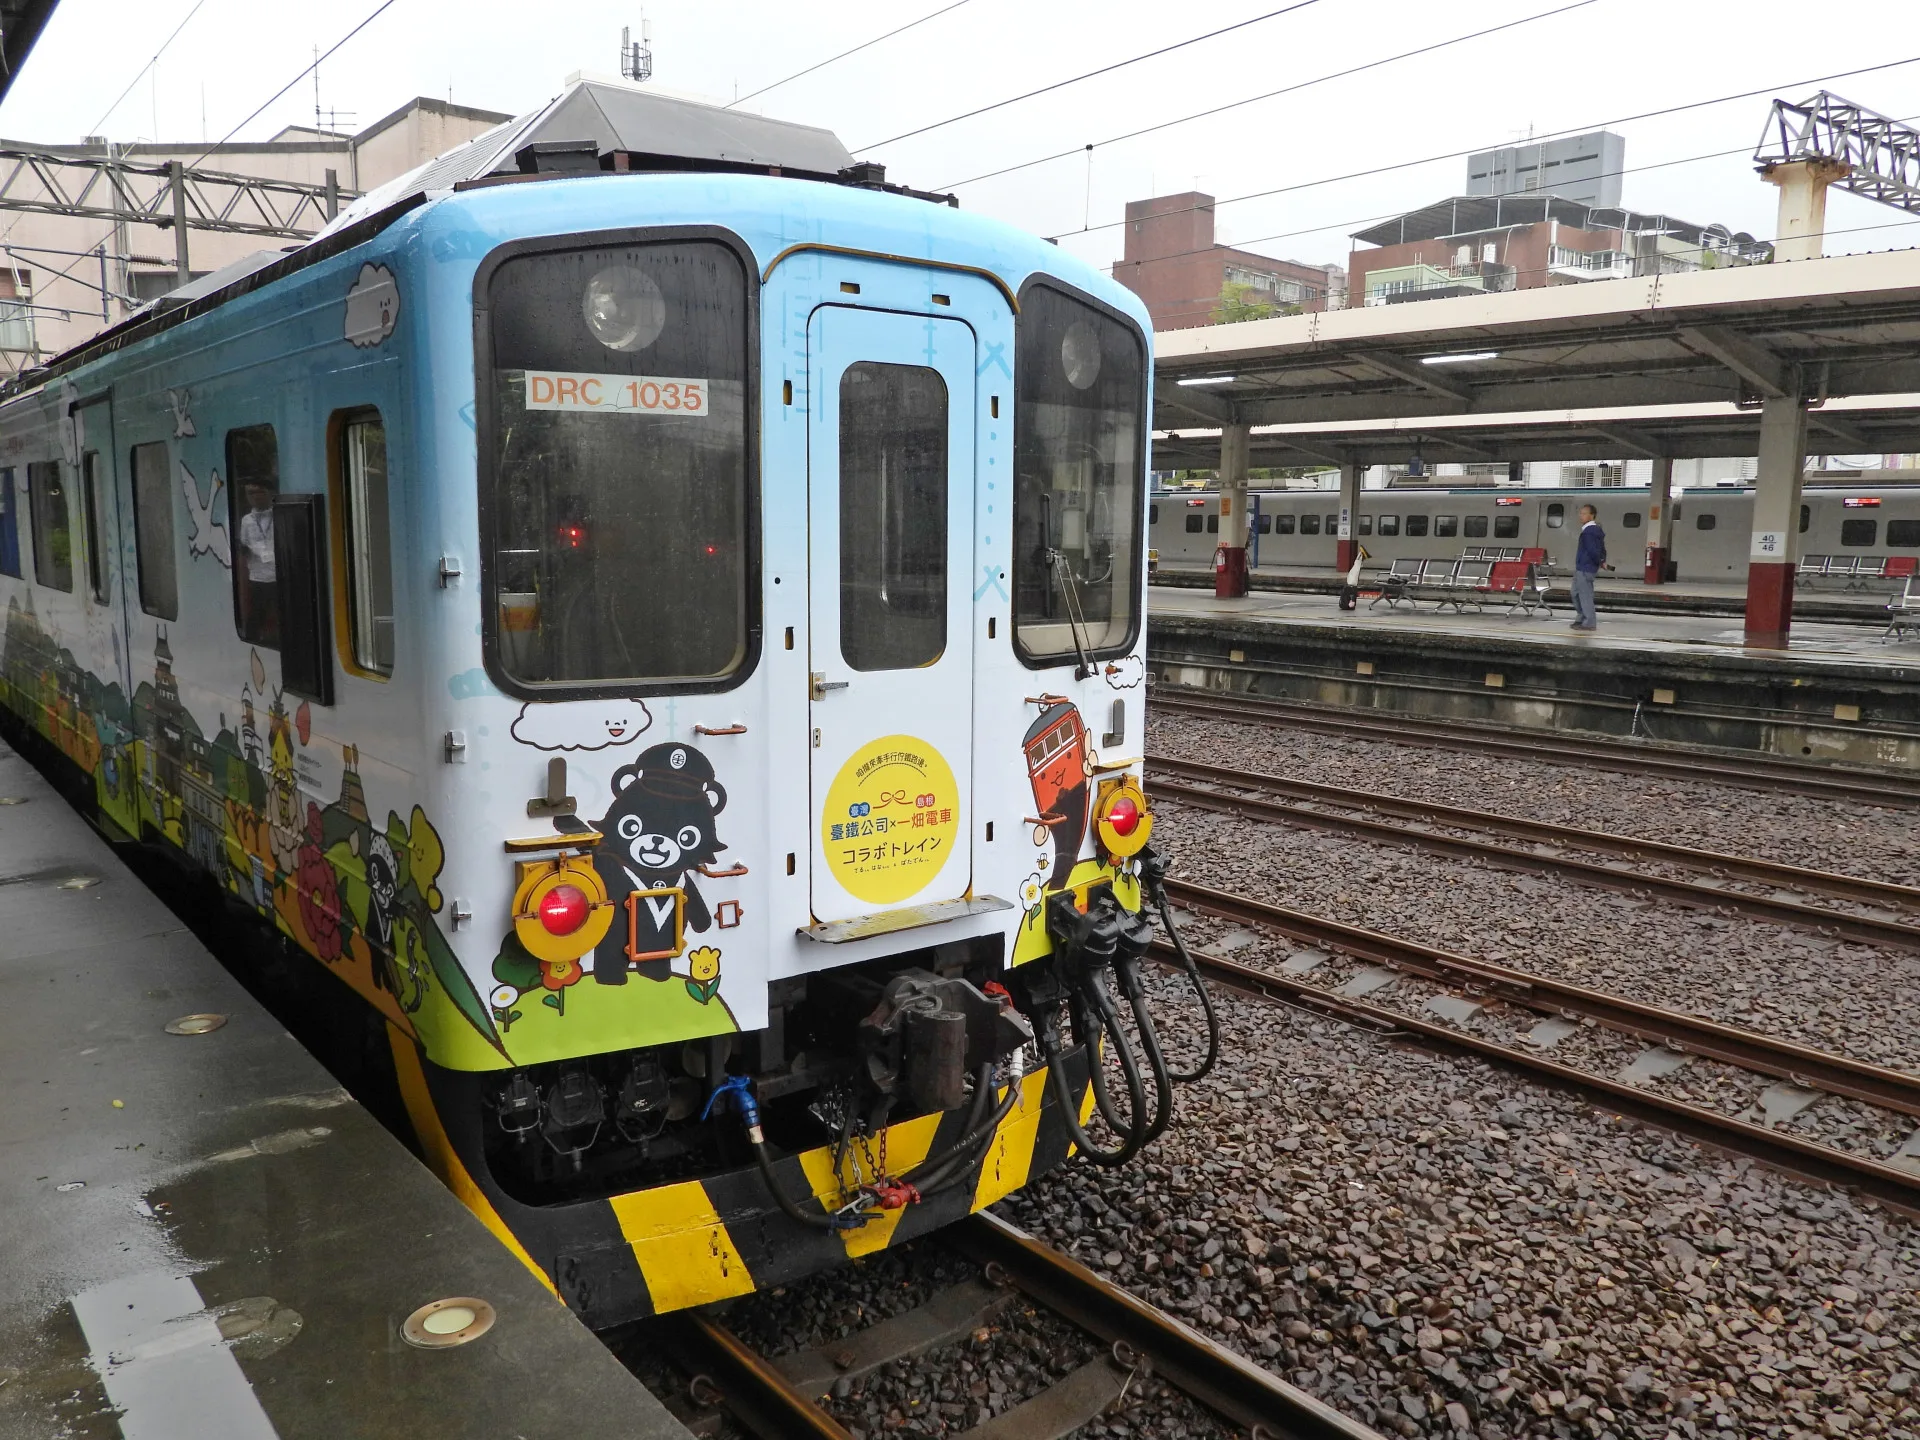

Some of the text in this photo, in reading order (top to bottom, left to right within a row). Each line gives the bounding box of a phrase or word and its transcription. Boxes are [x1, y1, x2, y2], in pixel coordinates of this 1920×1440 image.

[532, 376, 702, 411] DRC 1035
[851, 804, 869, 816] 臺灣
[917, 796, 934, 806] 島根
[843, 837, 942, 865] コラボトレイン
